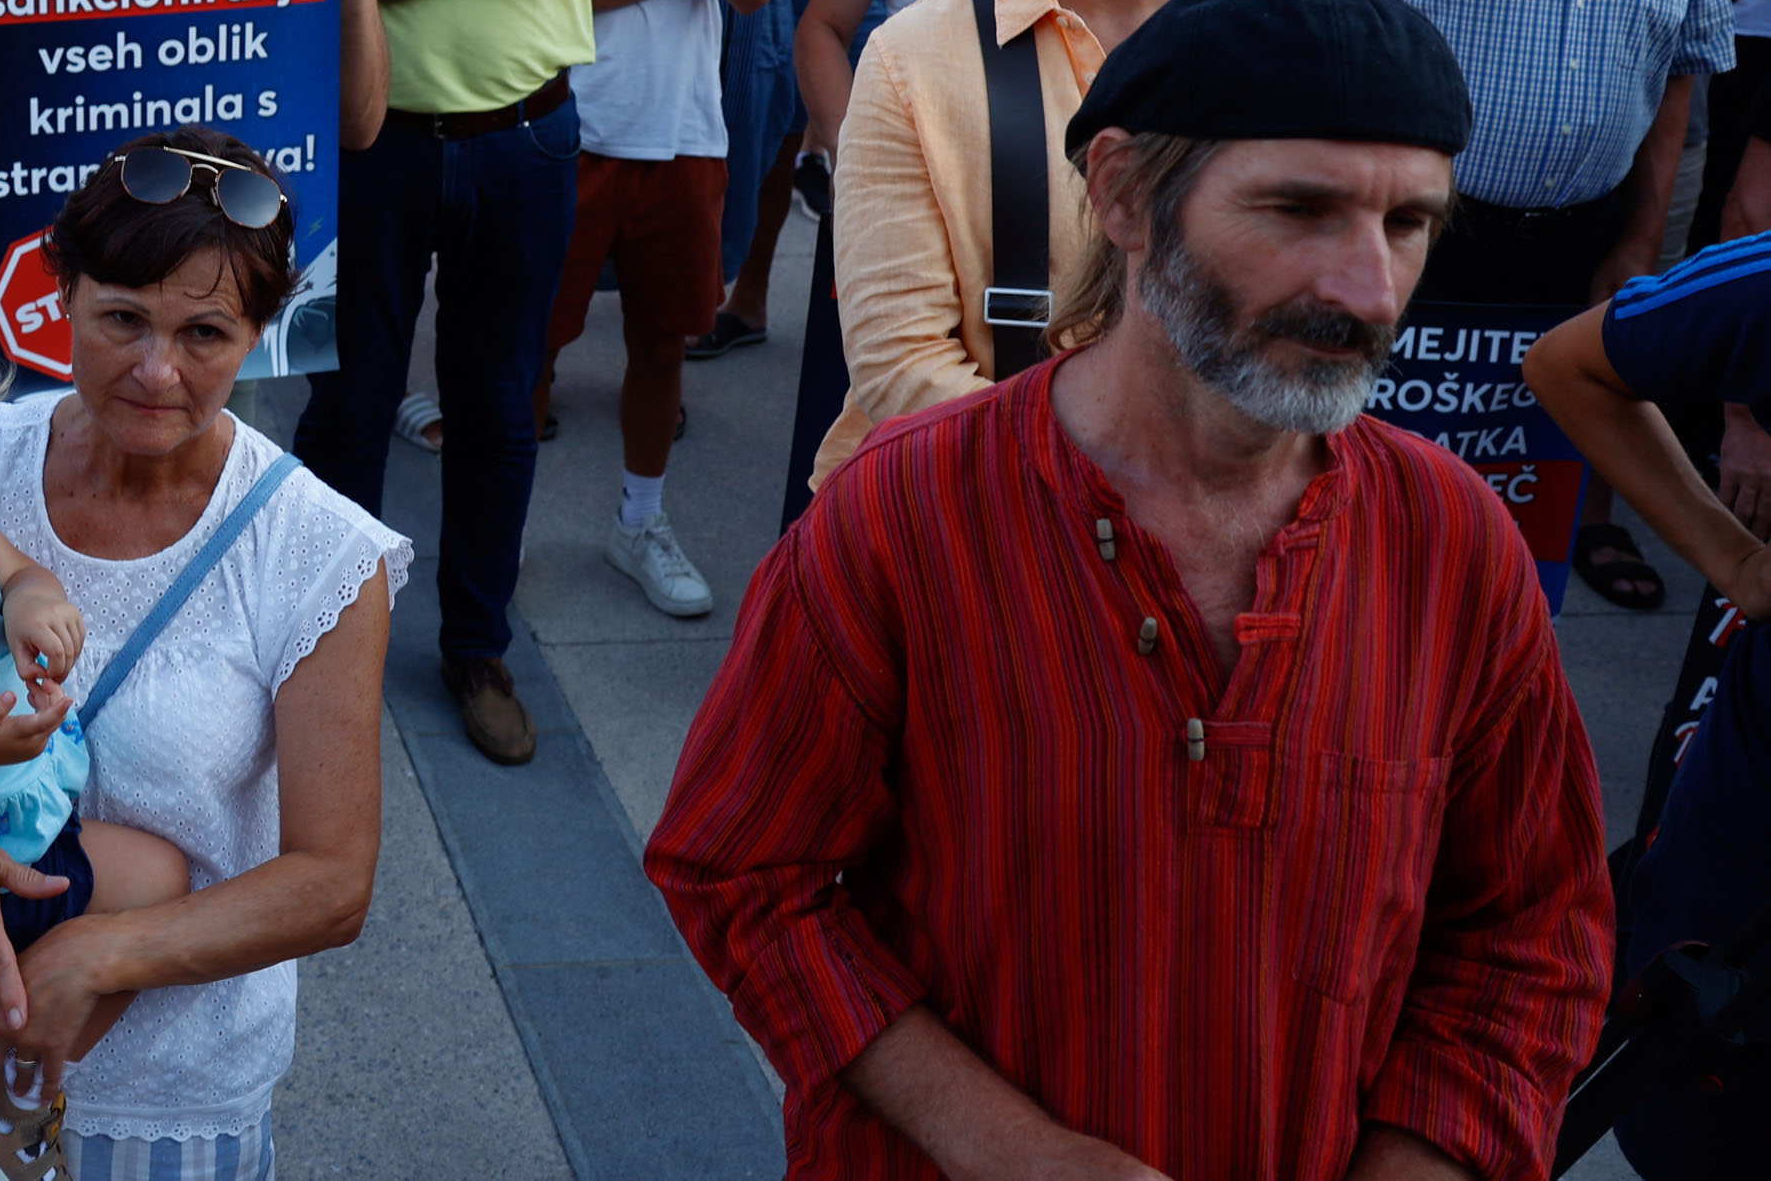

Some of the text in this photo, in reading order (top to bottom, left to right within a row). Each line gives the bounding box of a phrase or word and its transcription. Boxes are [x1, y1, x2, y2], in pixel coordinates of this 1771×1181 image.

[38, 22, 268, 74] vseh oblik
[29, 85, 278, 135] kriminala s
[1391, 324, 1540, 365] MEJITE
[1365, 371, 1541, 414] ROŠKEG
